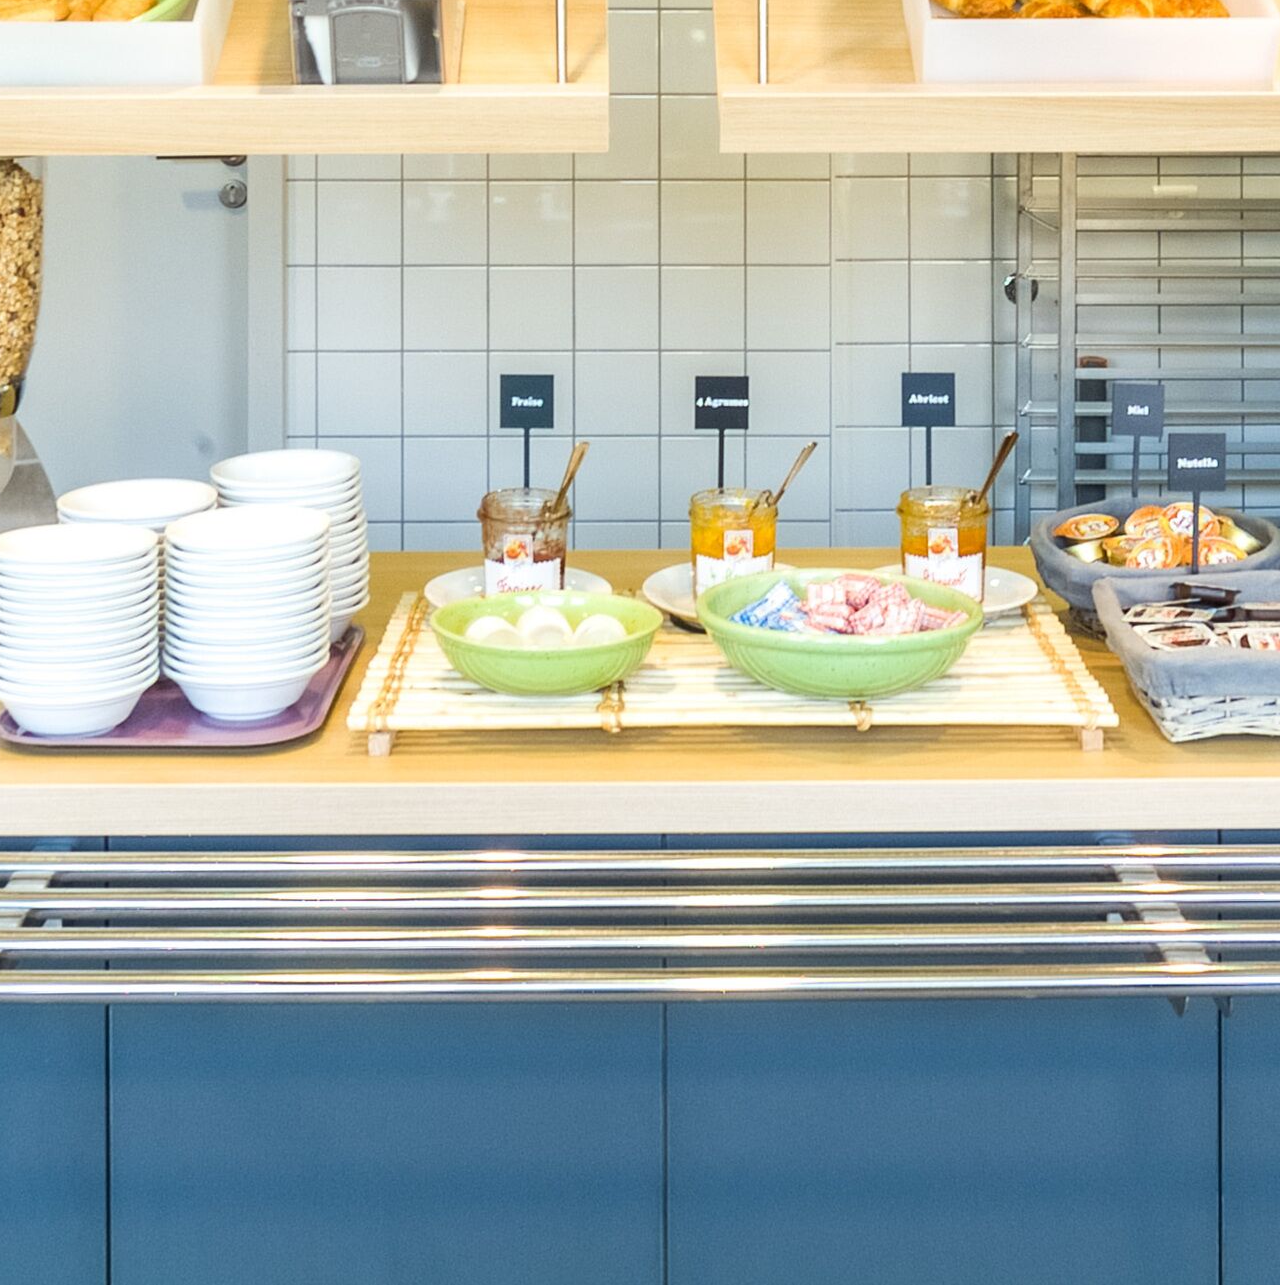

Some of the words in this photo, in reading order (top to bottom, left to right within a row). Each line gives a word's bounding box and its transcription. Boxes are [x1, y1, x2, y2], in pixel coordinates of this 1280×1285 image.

[511, 396, 544, 407] Fraise
[696, 397, 704, 407] 4
[704, 396, 749, 408] Agrumes
[908, 394, 950, 404] Abricot
[1177, 457, 1219, 469] Nutella
